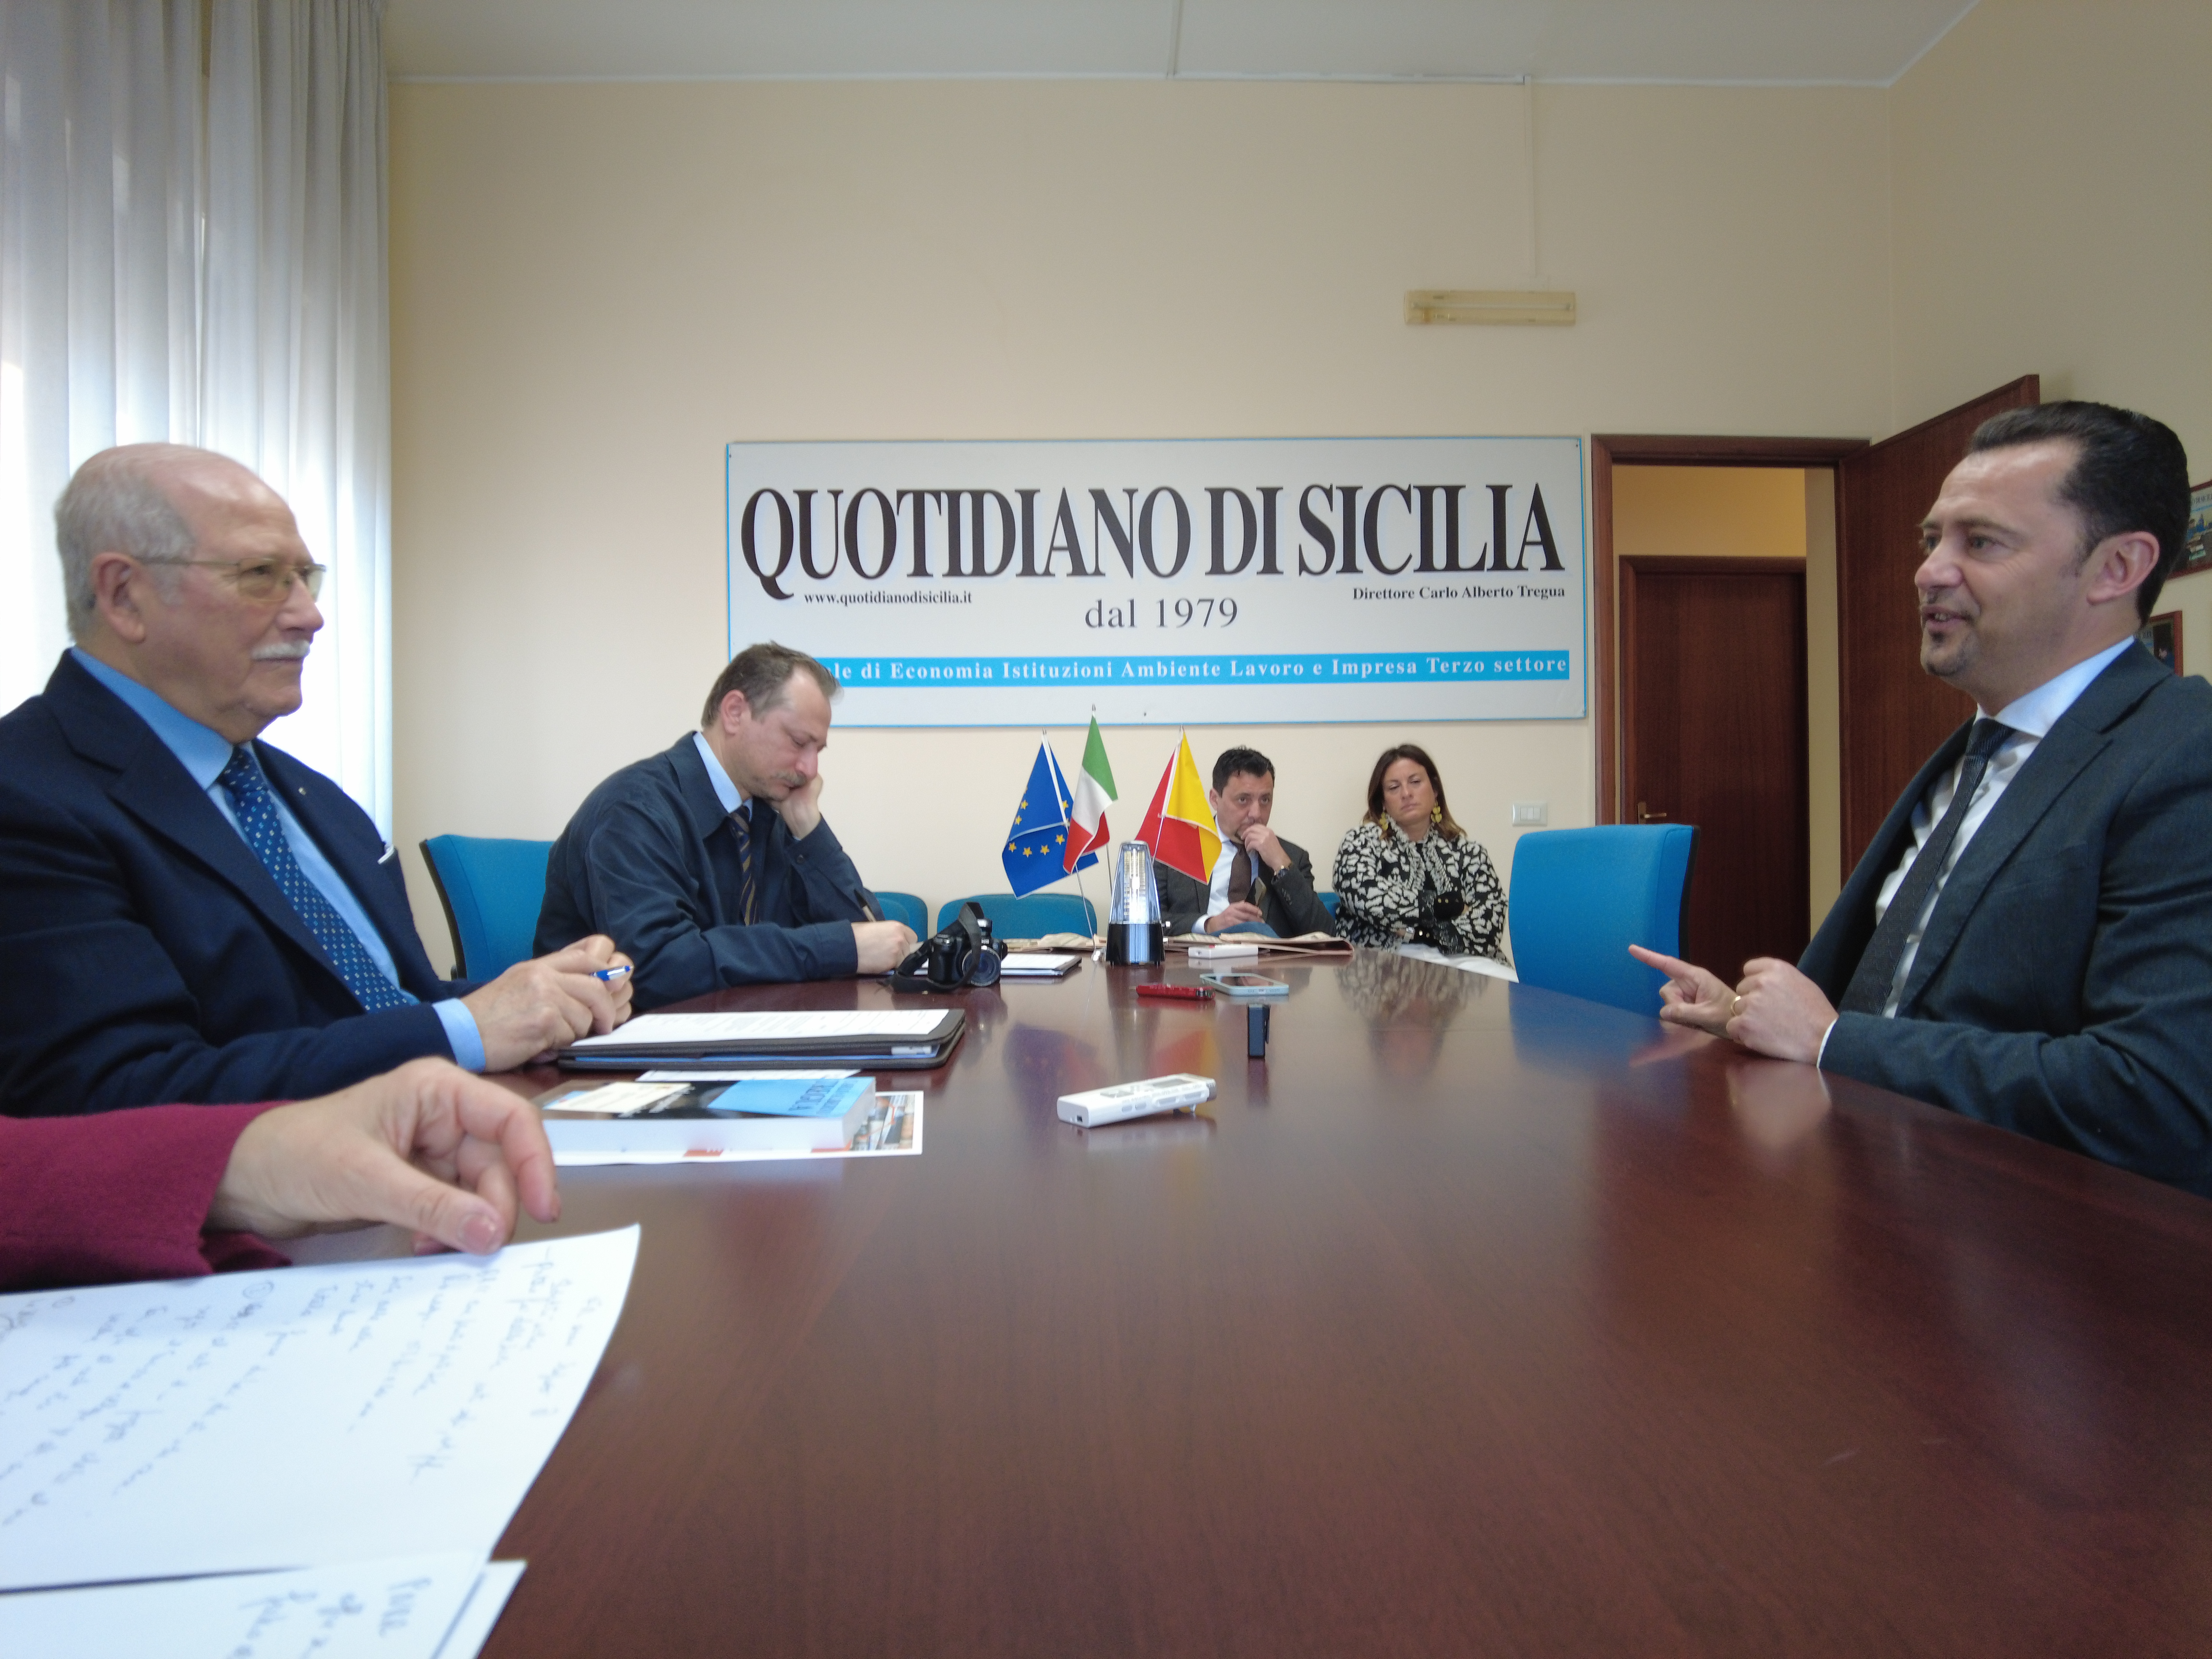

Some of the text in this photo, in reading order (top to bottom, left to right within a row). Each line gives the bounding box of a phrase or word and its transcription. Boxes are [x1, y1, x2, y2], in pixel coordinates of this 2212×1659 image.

[740, 483, 1565, 600] QUOTIDIANO DI SICILIA
[805, 591, 972, 606] www.quotidianodisicilia.it
[1354, 586, 1564, 600] Direttore Carlo Alberto Tregua
[1085, 599, 1238, 628] dal 1979
[861, 662, 880, 679] di
[890, 662, 994, 679] Economia
[1003, 661, 1112, 679] Istituzioni
[1121, 661, 1220, 677] Ambiente
[1230, 660, 1304, 676] Lavoro
[1313, 663, 1322, 675] e
[1332, 659, 1417, 679] Impresa
[1426, 657, 1485, 673] Terzo
[1494, 657, 1566, 673] settore
